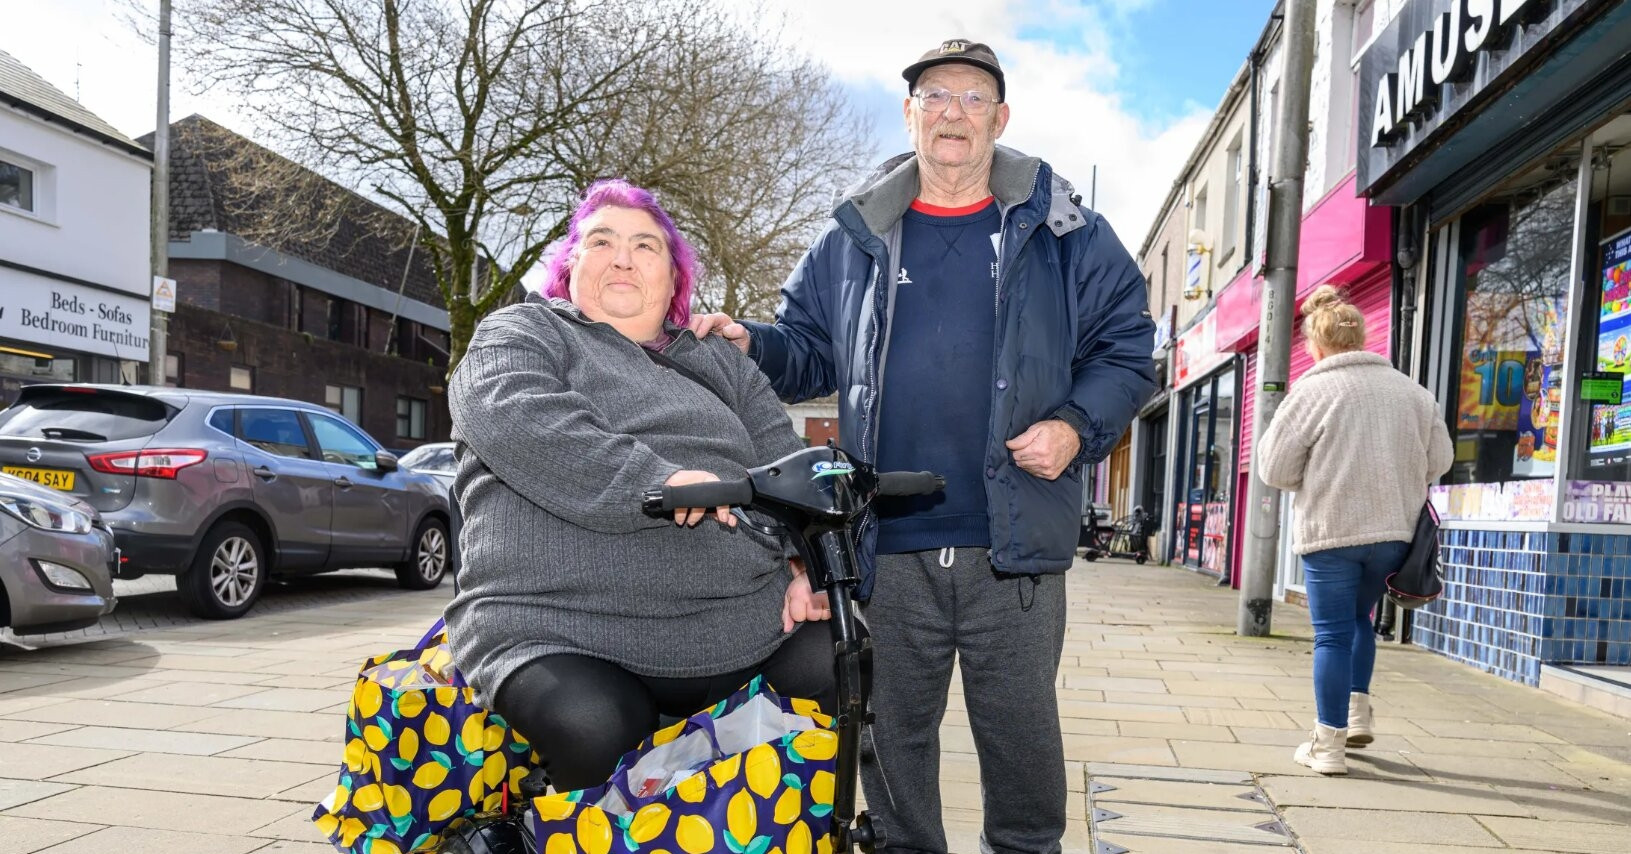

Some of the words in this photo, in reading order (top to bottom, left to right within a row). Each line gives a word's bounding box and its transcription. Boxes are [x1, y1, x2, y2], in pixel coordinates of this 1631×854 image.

[940, 41, 966, 54] CAT
[51, 291, 85, 315] Beds
[98, 302, 132, 325] Sofas
[21, 308, 88, 338] Bedroom
[1474, 360, 1525, 407] 10
[43, 472, 69, 488] SAY
[1563, 502, 1598, 521] OLD
